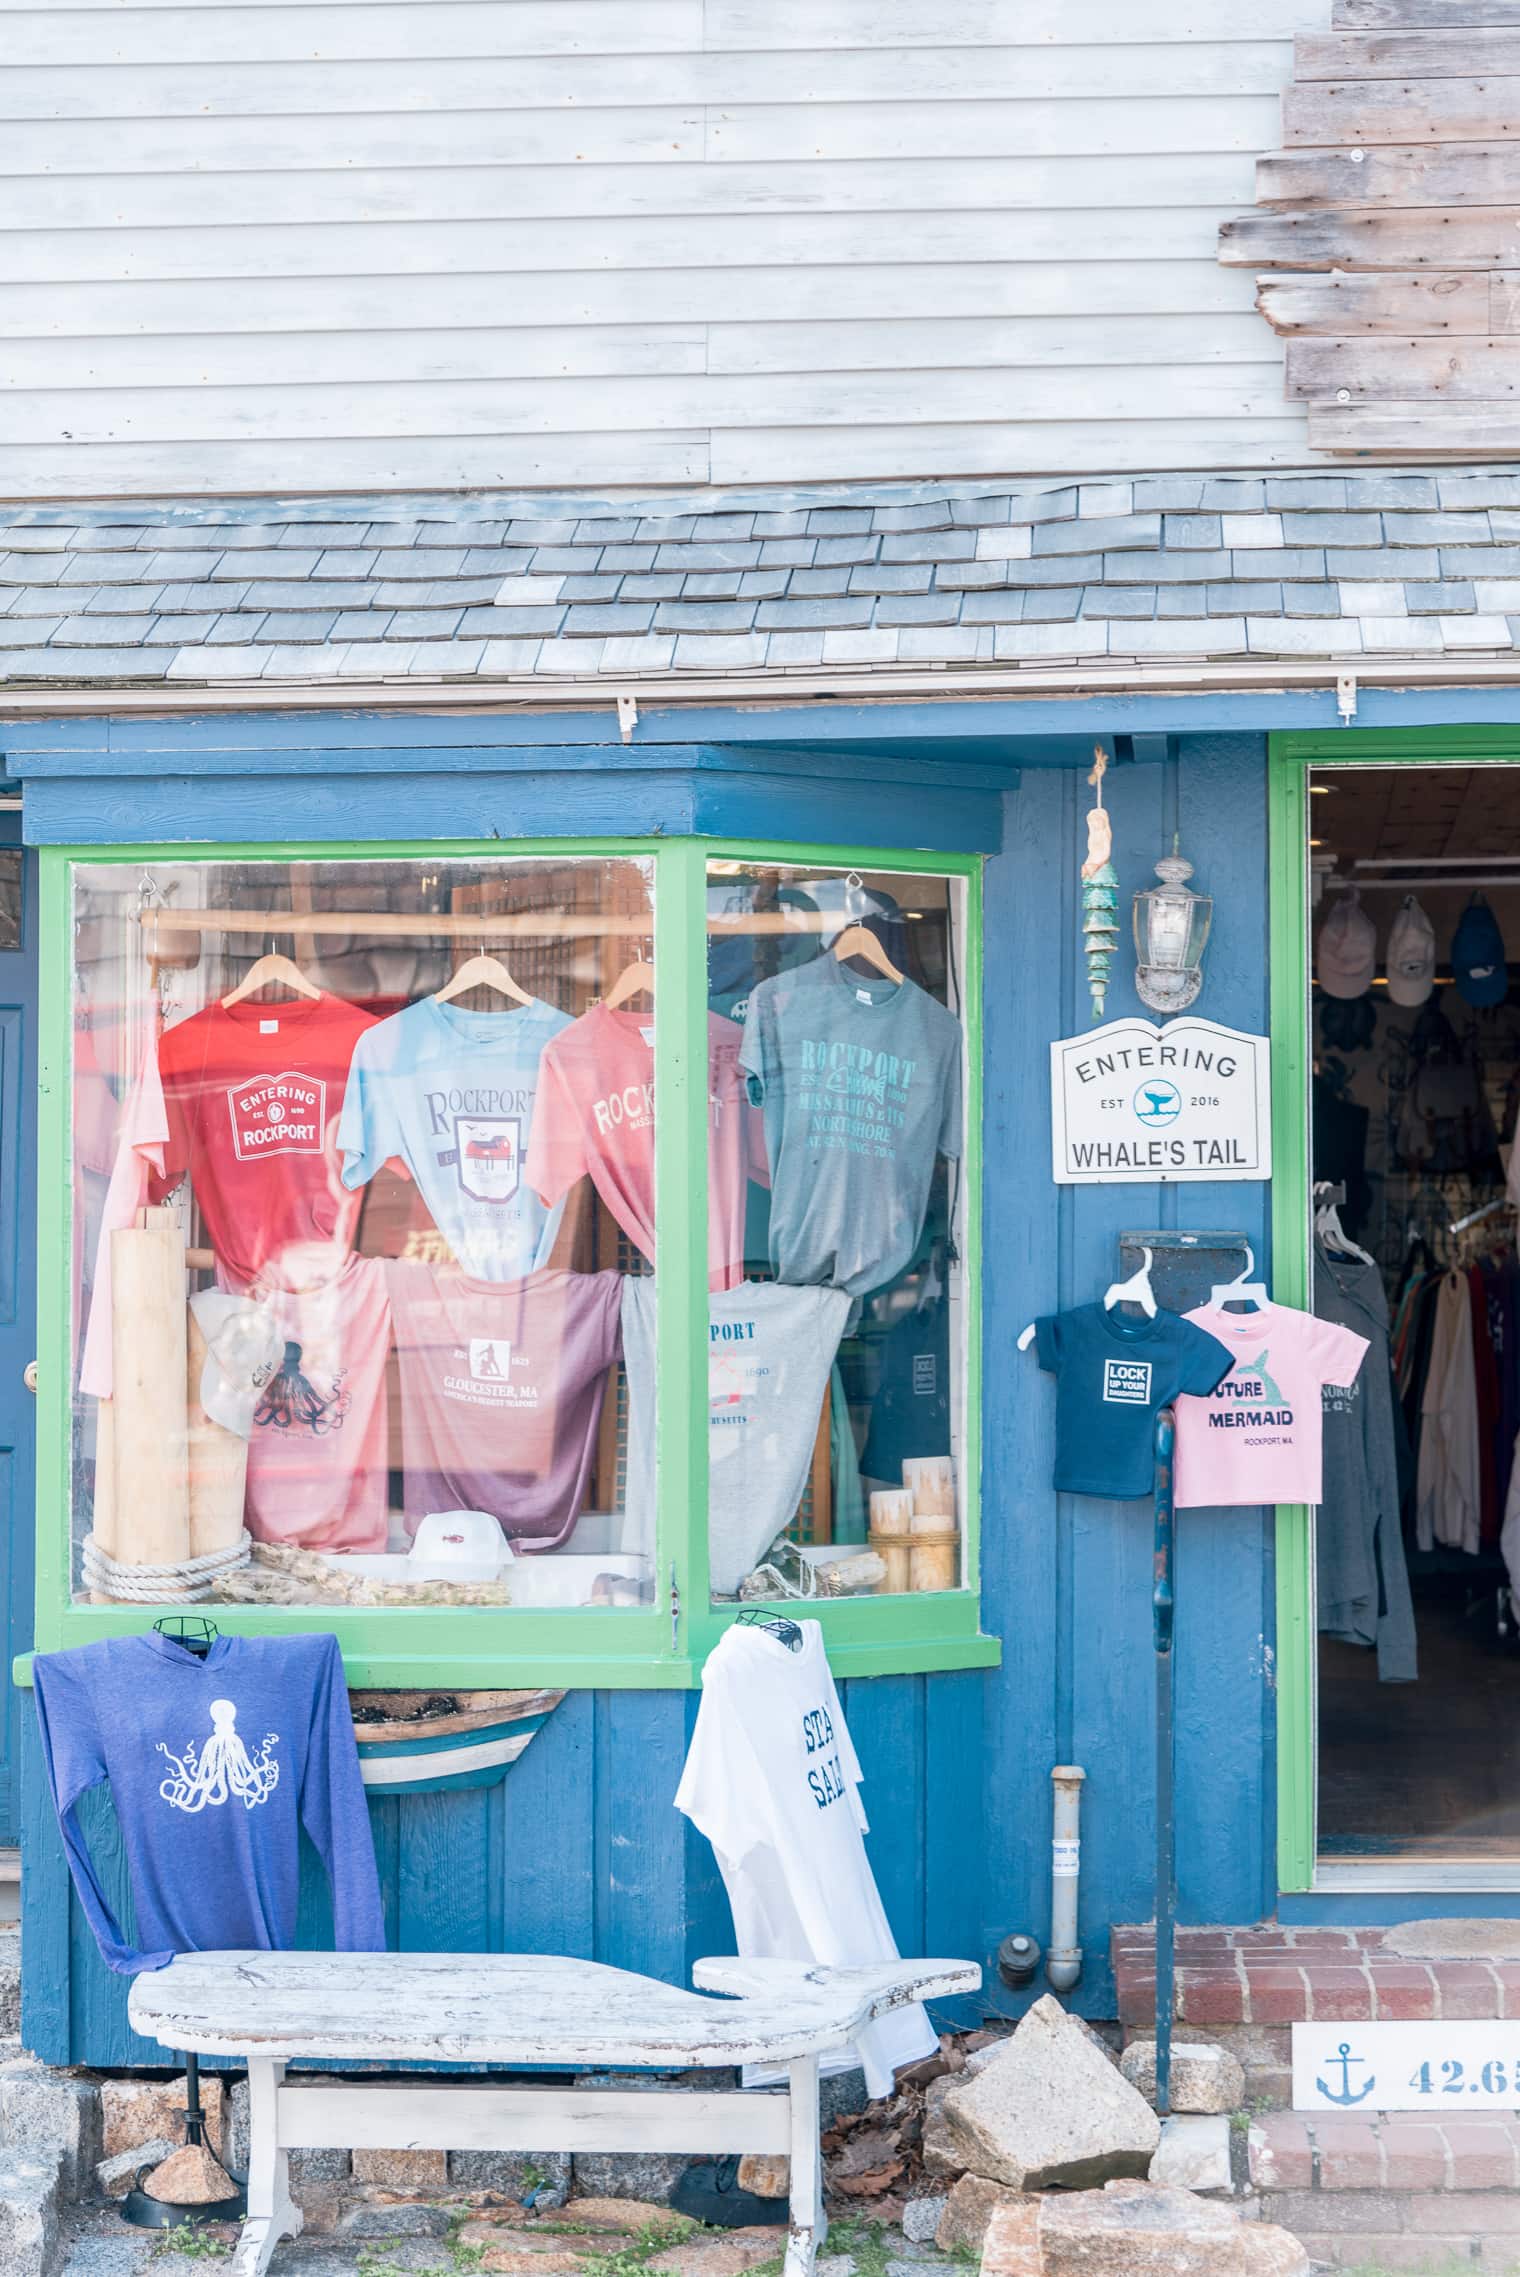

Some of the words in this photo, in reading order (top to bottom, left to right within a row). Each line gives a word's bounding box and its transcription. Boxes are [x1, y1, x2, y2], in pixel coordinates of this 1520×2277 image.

[1075, 1046, 1238, 1083] ENTERING
[240, 1086, 317, 1112] ENTERING
[1100, 1098, 1125, 1109] EST
[1190, 1096, 1220, 1107] 2016
[243, 1124, 316, 1146] ROCKPORT
[1072, 1140, 1186, 1168] WHALE'S
[1192, 1139, 1247, 1165] TAIL
[1110, 1365, 1146, 1381] LOCK
[1208, 1410, 1294, 1428] MERMAID
[1408, 2060, 1520, 2094] 42.6
